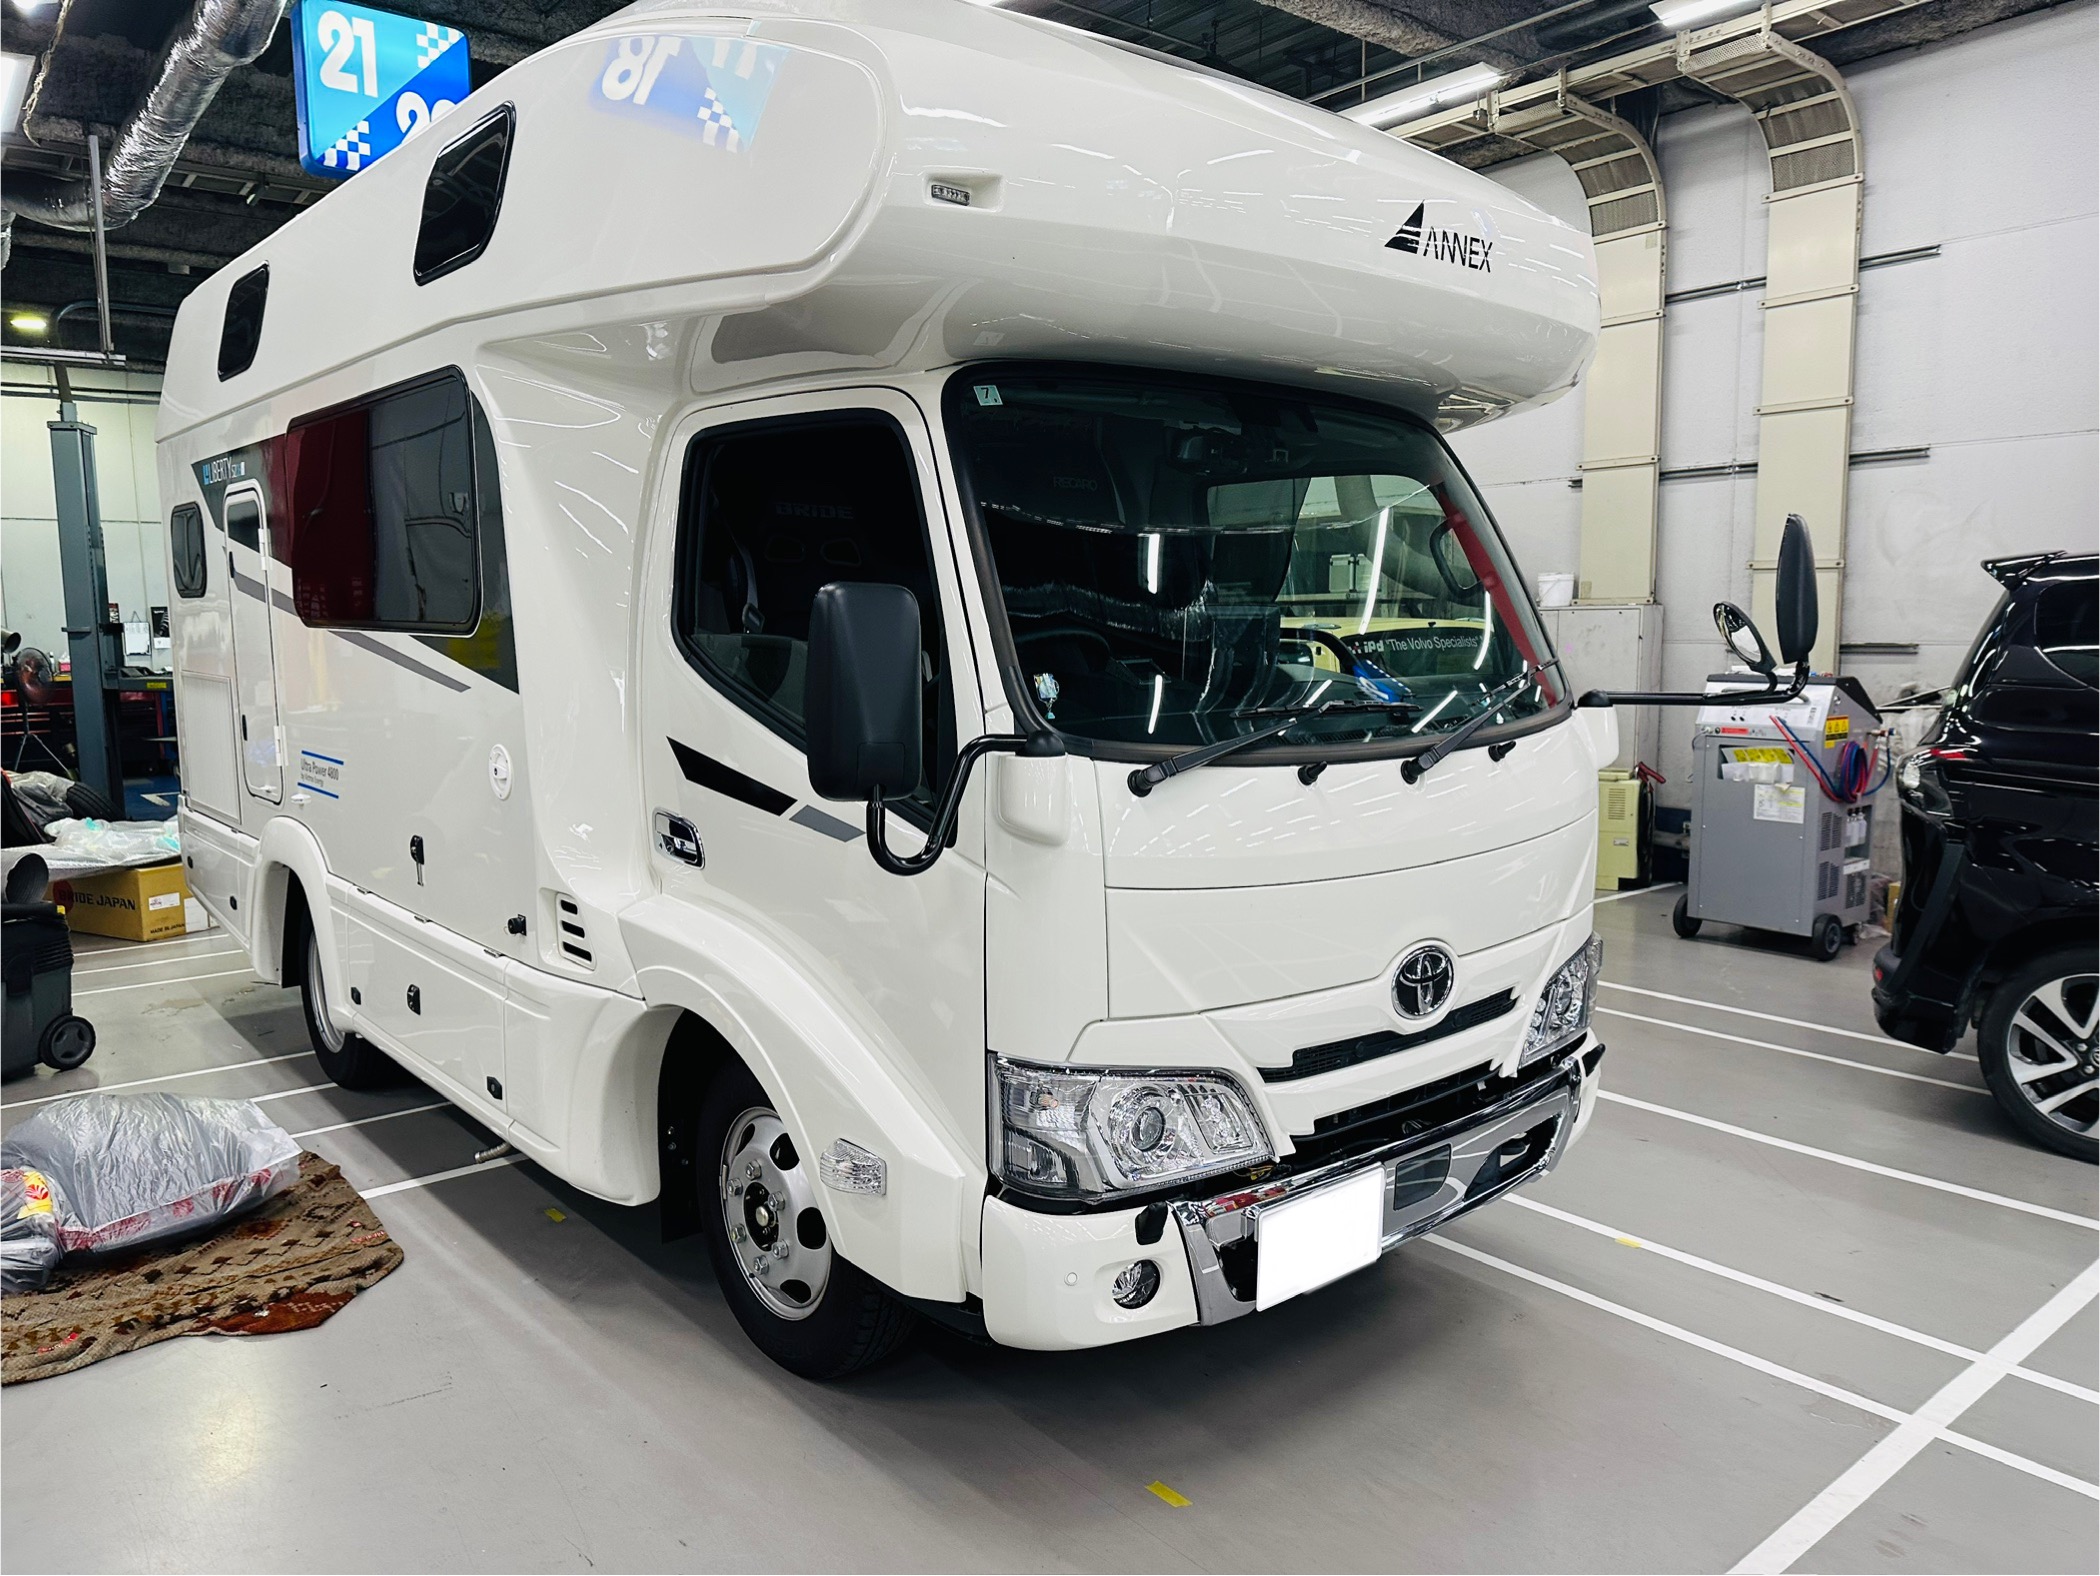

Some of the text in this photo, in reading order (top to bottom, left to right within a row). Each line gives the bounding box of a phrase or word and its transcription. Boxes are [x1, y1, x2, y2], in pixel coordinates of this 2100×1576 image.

[317, 10, 379, 99] 21
[395, 91, 457, 146] 2
[1422, 226, 1494, 274] ANNEX
[981, 387, 989, 399] 7
[1054, 477, 1098, 491] RECARO
[776, 502, 853, 519] BRIDE
[1406, 636, 1434, 650] Volvo
[96, 894, 136, 911] JAPAN
